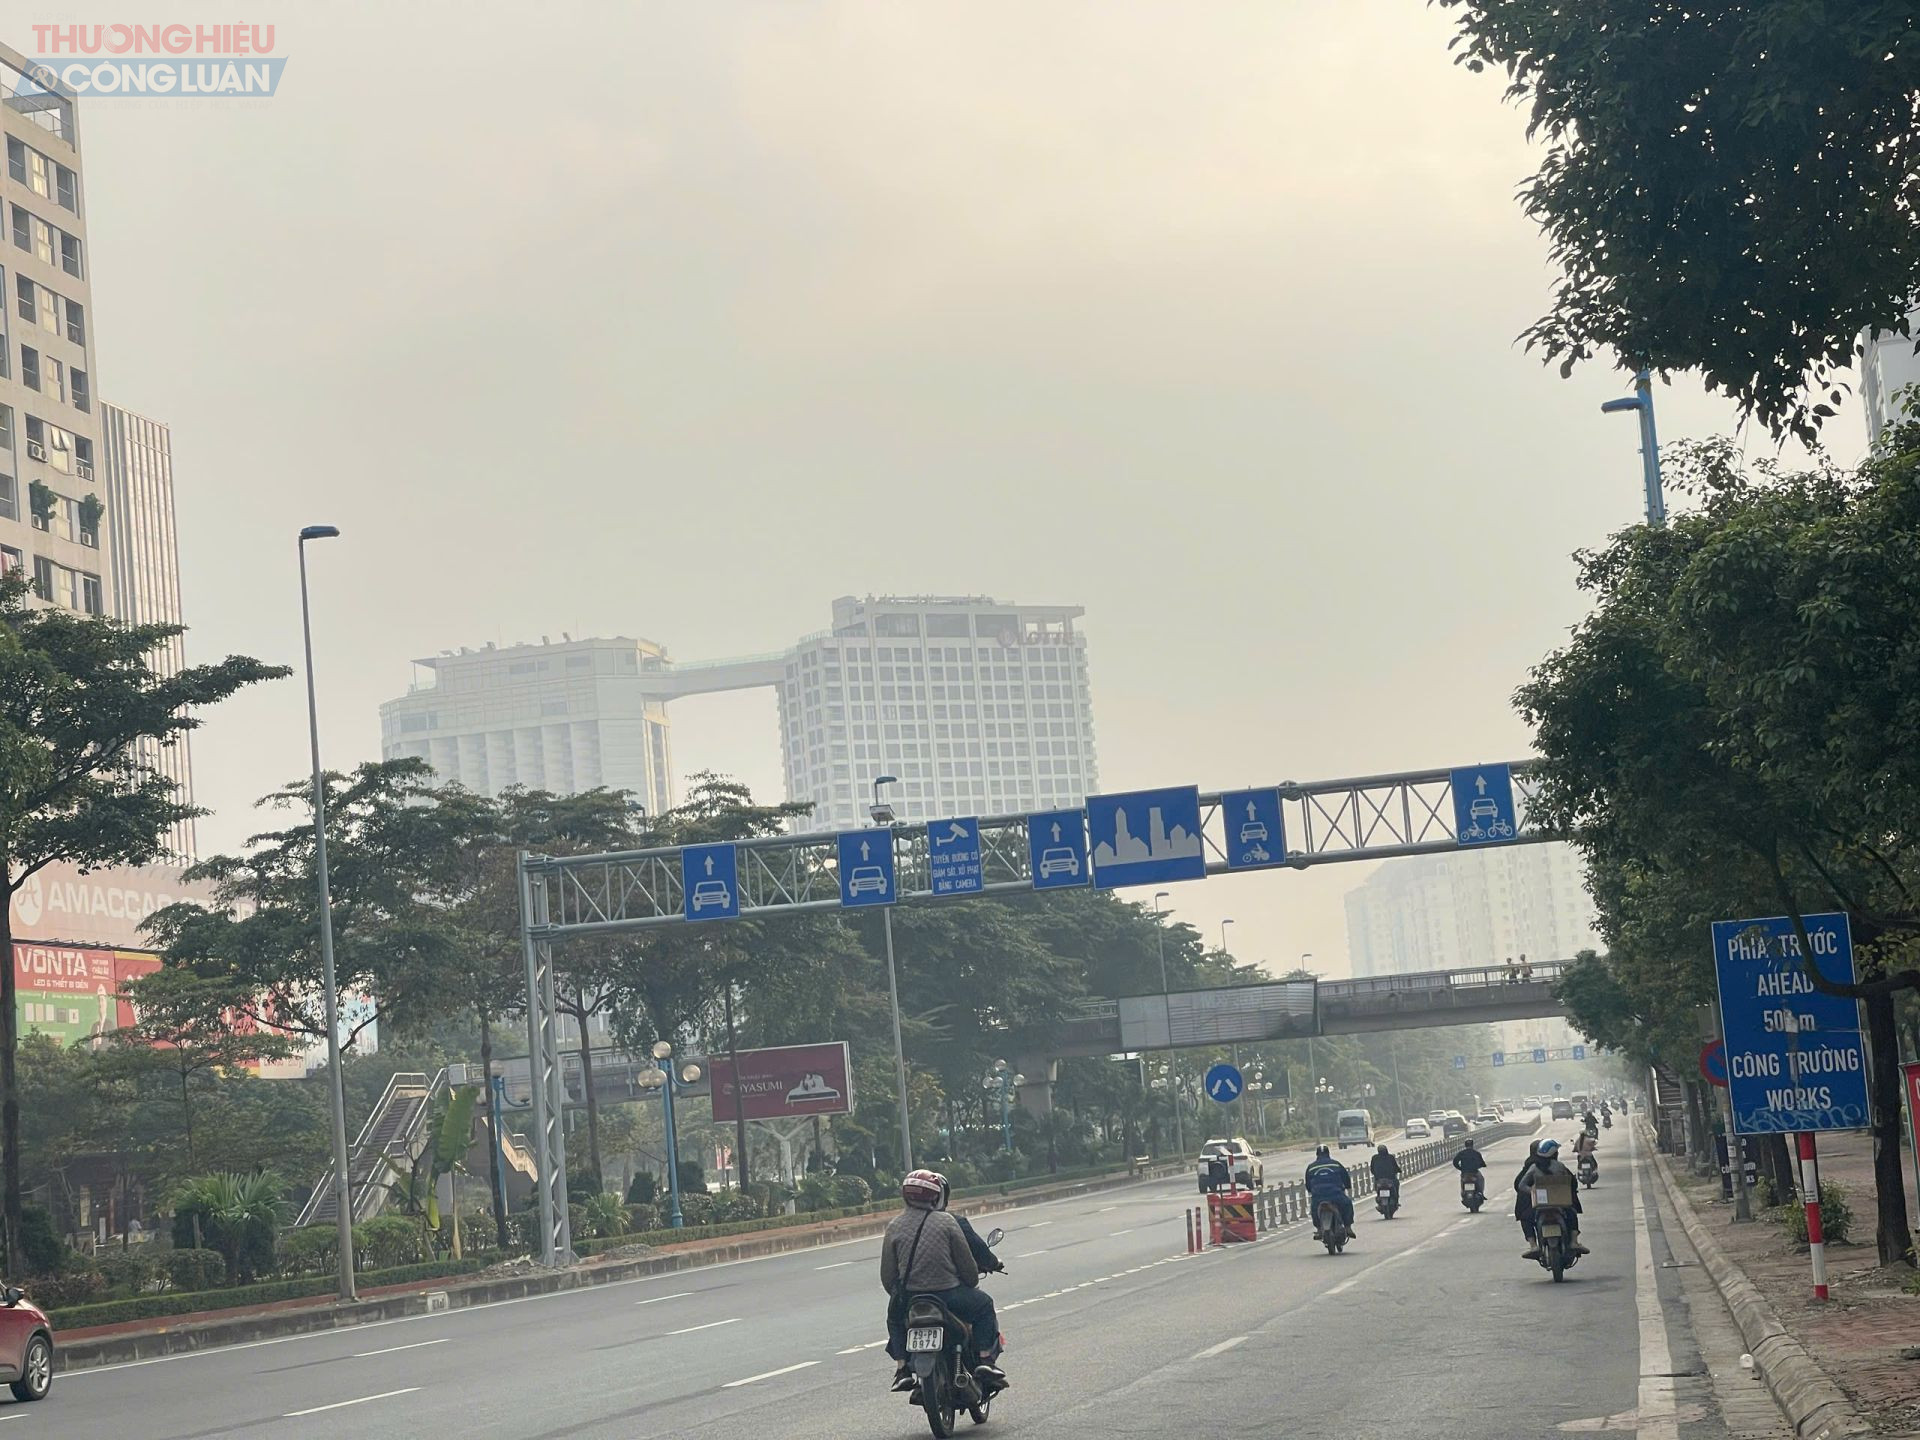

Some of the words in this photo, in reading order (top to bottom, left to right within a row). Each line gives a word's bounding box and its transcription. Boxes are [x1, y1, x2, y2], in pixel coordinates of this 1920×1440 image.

[17, 947, 88, 976] VONTA
[1732, 1051, 1780, 1078] CÔNG
[1785, 1044, 1859, 1075] TRƯỜNG
[739, 1081, 784, 1094] YASUMI
[1765, 1086, 1832, 1112] WORKS
